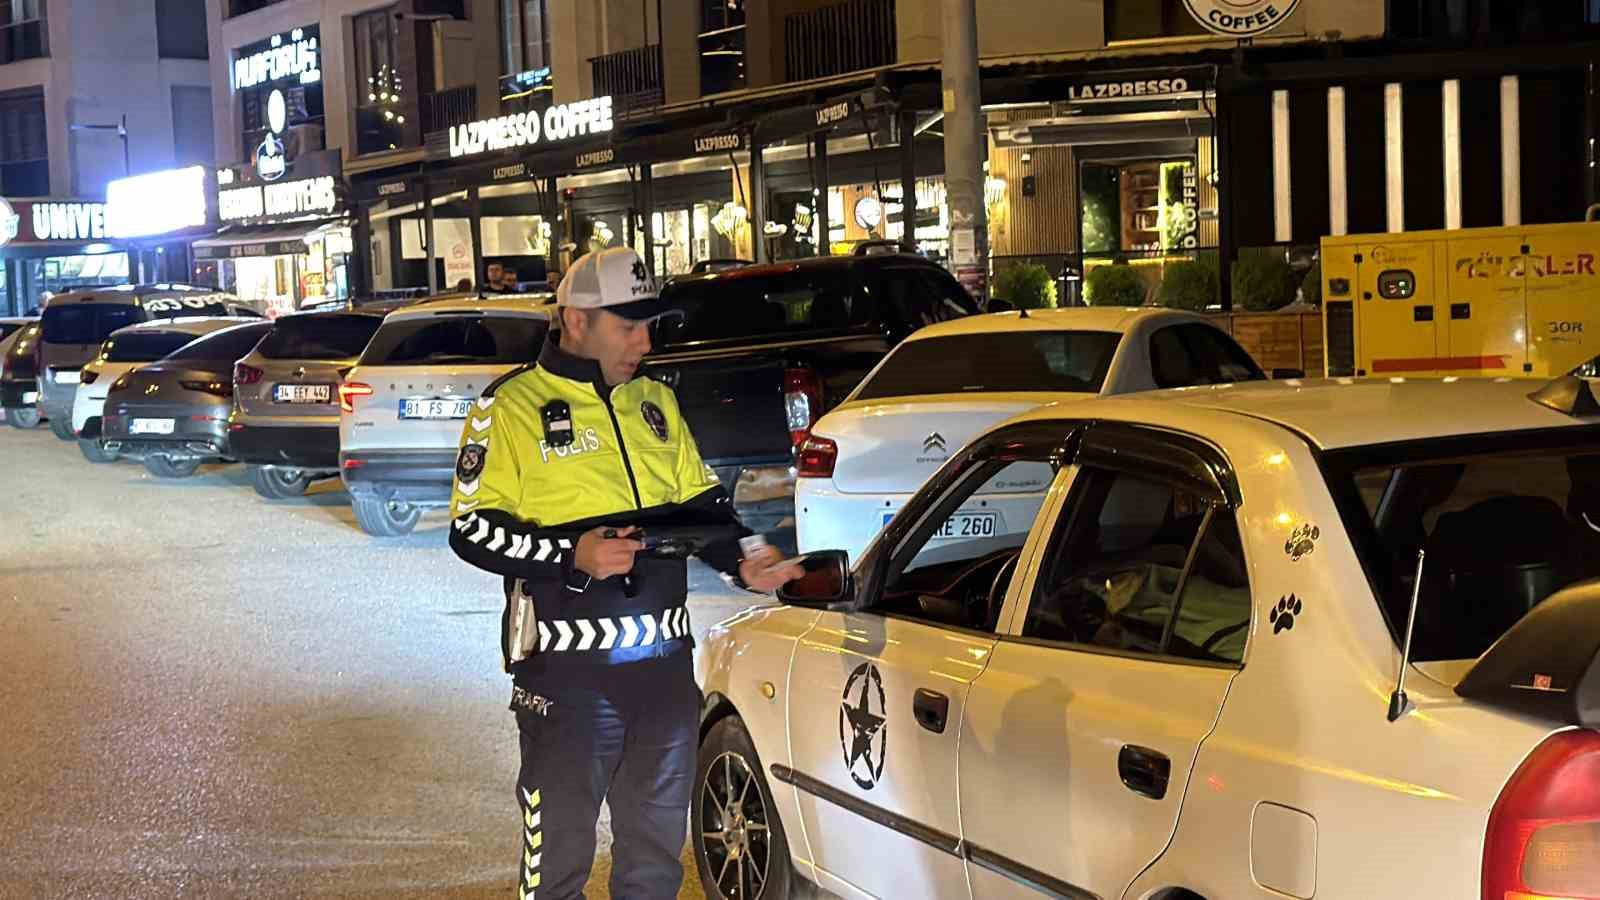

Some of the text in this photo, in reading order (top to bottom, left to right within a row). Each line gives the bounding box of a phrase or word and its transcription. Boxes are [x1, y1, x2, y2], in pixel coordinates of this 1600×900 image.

[1208, 5, 1279, 29] COFFEE
[1069, 78, 1188, 100] LAZPRESSO
[816, 102, 849, 126] LAZPRESSO
[449, 95, 614, 157] LAZPRESSO COFFEE
[694, 134, 739, 153] LAZPRESSO
[576, 149, 614, 168] LAZPRESSO
[1184, 167, 1197, 234] COFFEE
[314, 386, 329, 398] 442
[406, 402, 419, 415] 81
[429, 402, 443, 415] FS
[961, 516, 993, 536] 260
